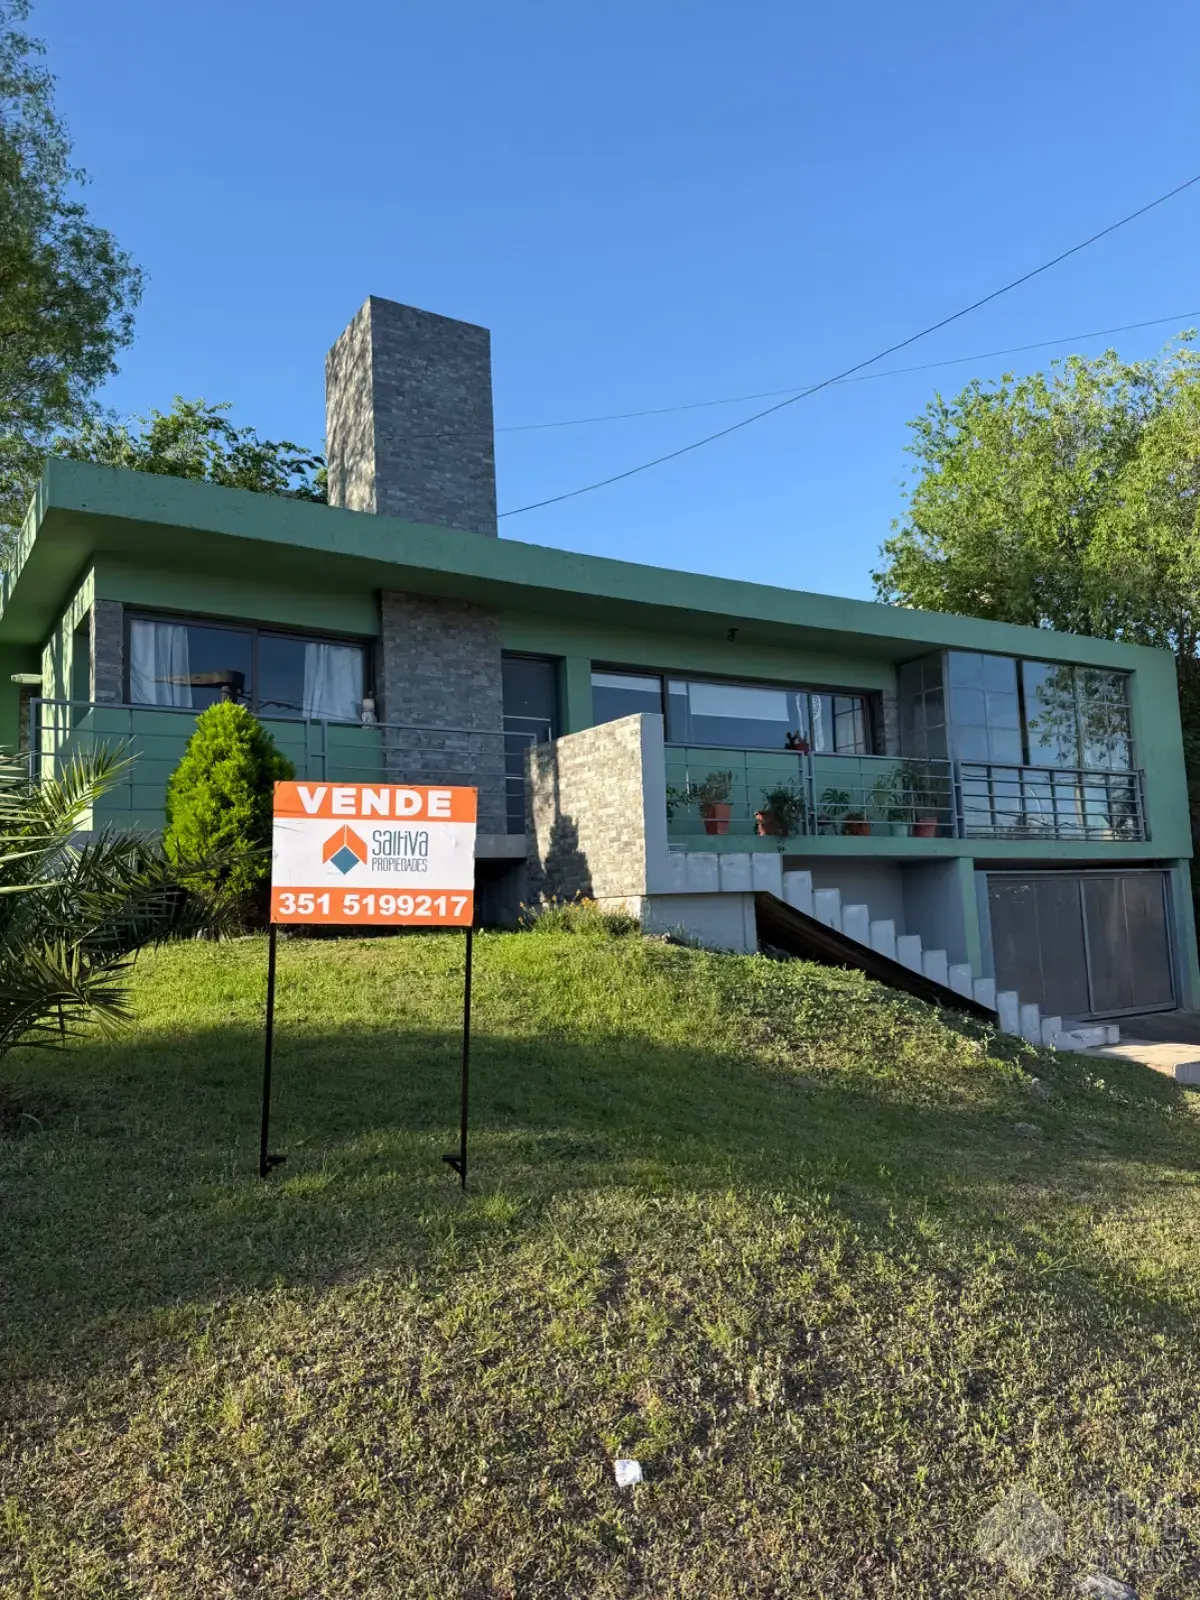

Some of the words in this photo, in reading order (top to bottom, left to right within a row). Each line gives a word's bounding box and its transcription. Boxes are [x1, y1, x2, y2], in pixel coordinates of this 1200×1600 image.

[296, 786, 452, 817] VENDE
[371, 858, 427, 872] PROPIEDADES
[279, 893, 330, 915] 351
[343, 895, 468, 917] 5199217
